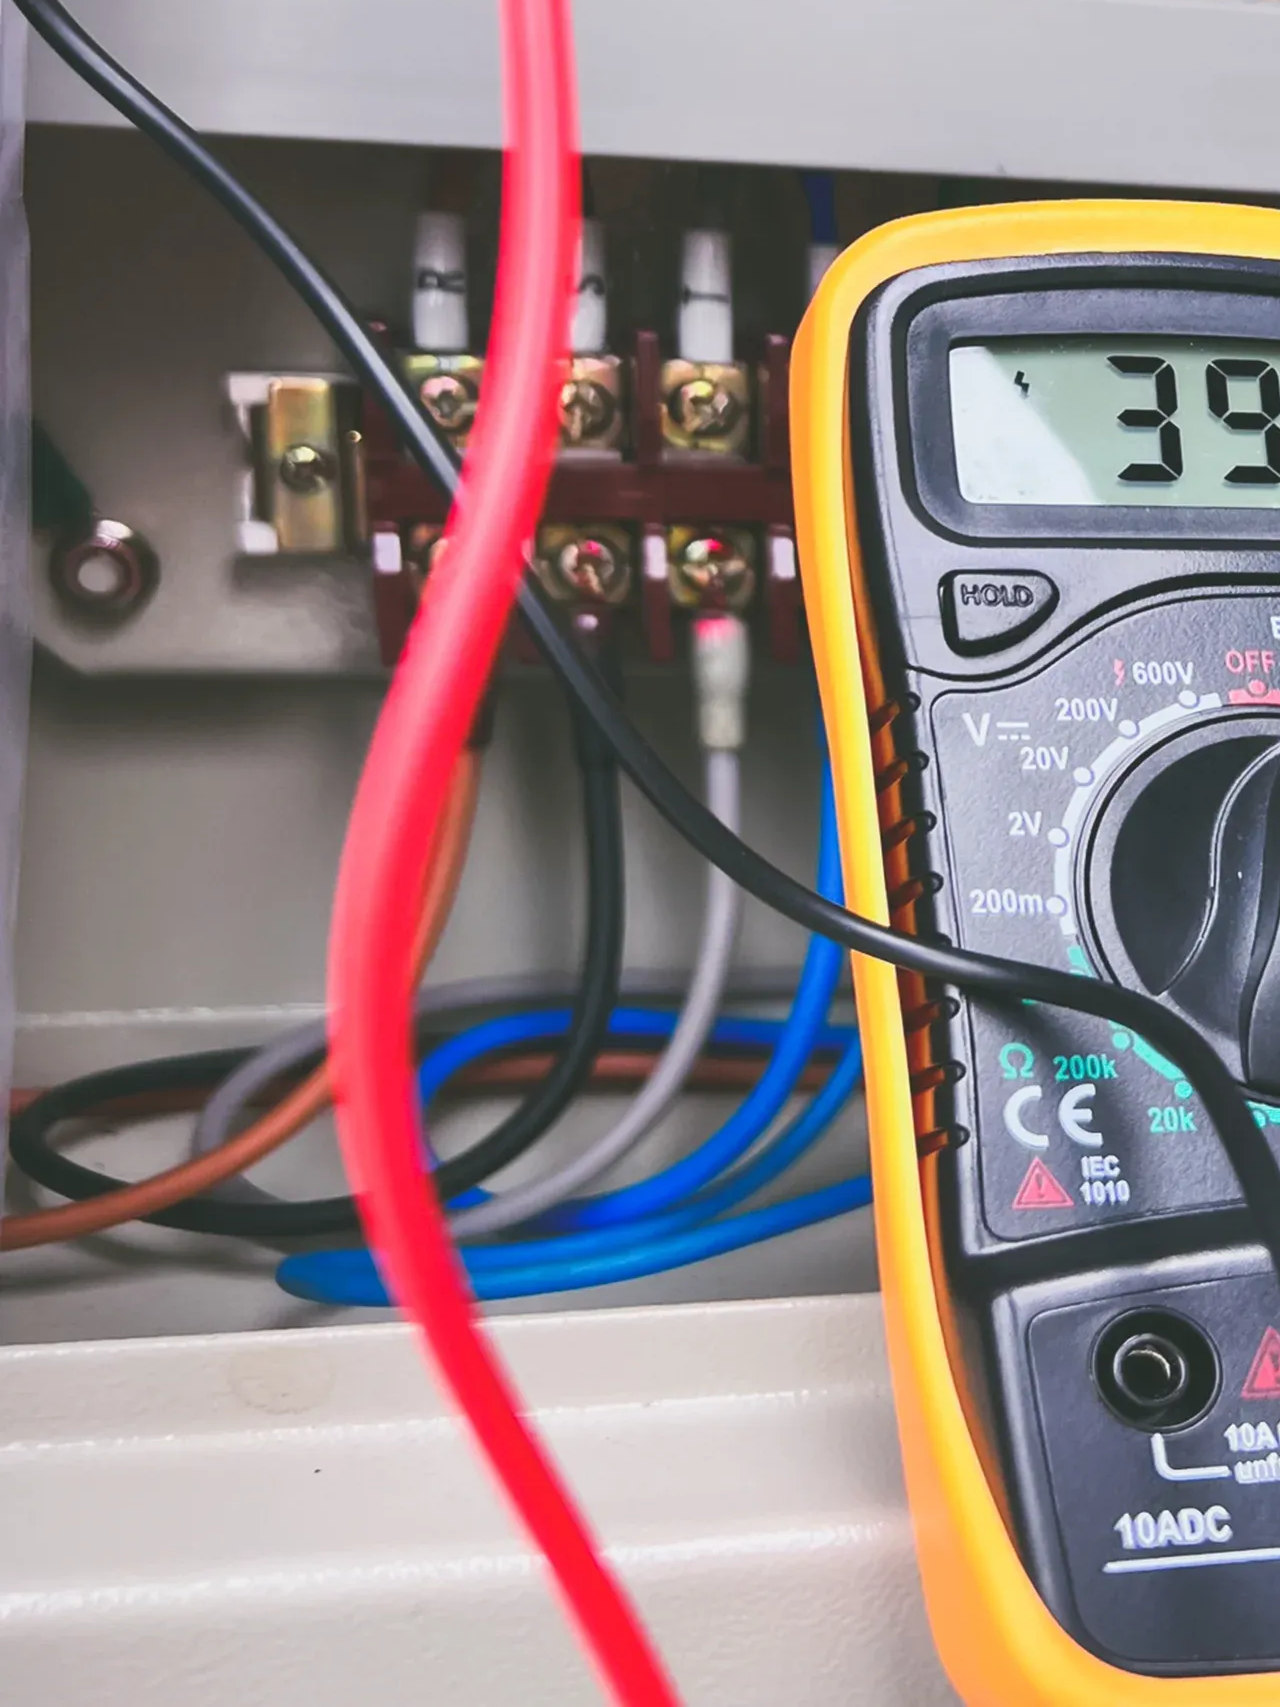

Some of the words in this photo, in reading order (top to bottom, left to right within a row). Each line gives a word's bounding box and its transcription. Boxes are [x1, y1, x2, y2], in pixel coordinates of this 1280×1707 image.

[960, 584, 1034, 608] HOLD
[1132, 661, 1194, 685] 600V
[1225, 650, 1275, 673] OFF
[1055, 698, 1118, 722] 200V
[1020, 747, 1069, 770] 20V
[1008, 812, 1042, 836] 2V
[970, 889, 1045, 914] 200m
[1053, 1055, 1118, 1081] 200k
[1148, 1106, 1197, 1133] 20k
[1081, 1155, 1121, 1179] IEC
[1079, 1179, 1131, 1205] 1010
[1224, 1421, 1277, 1452] 10A
[1114, 1505, 1233, 1550] 10ADC
